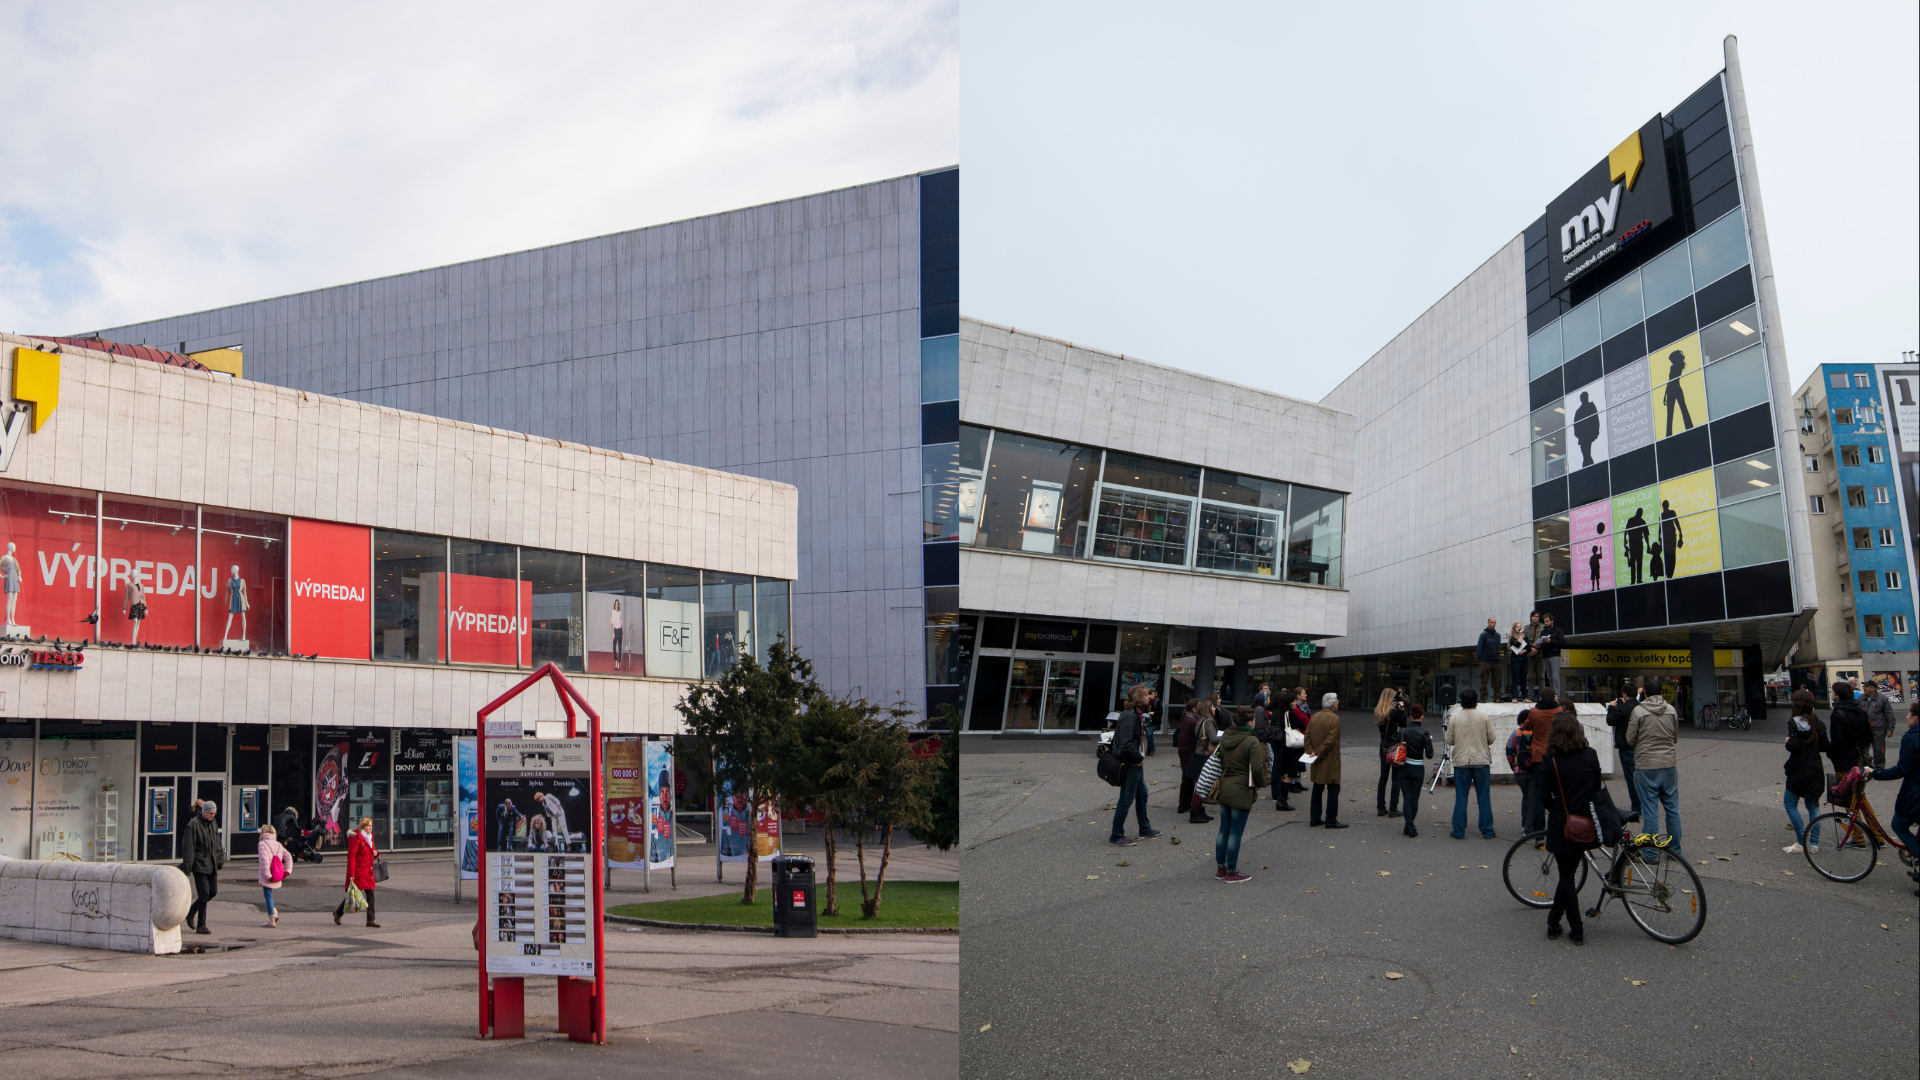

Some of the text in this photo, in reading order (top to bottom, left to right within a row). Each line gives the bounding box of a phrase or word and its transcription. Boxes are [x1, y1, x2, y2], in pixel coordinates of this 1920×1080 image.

[1561, 183, 1622, 253] my
[1563, 232, 1600, 263] bratislava
[1596, 242, 1618, 260] domy
[1617, 219, 1651, 243] TESCO
[1611, 381, 1645, 405] Apricot
[1626, 396, 1646, 409] Roma
[1612, 404, 1647, 426] Desigual
[1613, 417, 1648, 436] Tescoma
[1665, 485, 1686, 496] Apricot
[1618, 490, 1653, 508] Time Out
[1690, 498, 1709, 511] Out
[1574, 503, 1607, 520] Desigual
[1683, 513, 1710, 526] Designs
[1682, 530, 1712, 547] sigual
[1689, 547, 1713, 559] Roma
[38, 543, 218, 599] VÝPREDAJ
[294, 578, 365, 602] VÝPREDAJ
[445, 606, 528, 636] VÝPREDAJ
[662, 625, 691, 648] F&F
[31, 650, 84, 665] TESCO
[1617, 654, 1631, 663] na
[1633, 653, 1667, 665] všetky
[489, 722, 517, 731] ewe
[419, 738, 438, 746] ESPRIT
[0, 757, 31, 773] Dove
[40, 757, 89, 777] 60 rokov
[395, 764, 416, 772] DKNY
[520, 770, 543, 778] JANUÁR
[612, 769, 622, 778] 100
[622, 769, 632, 778] 000
[528, 780, 544, 788] Sylvia
